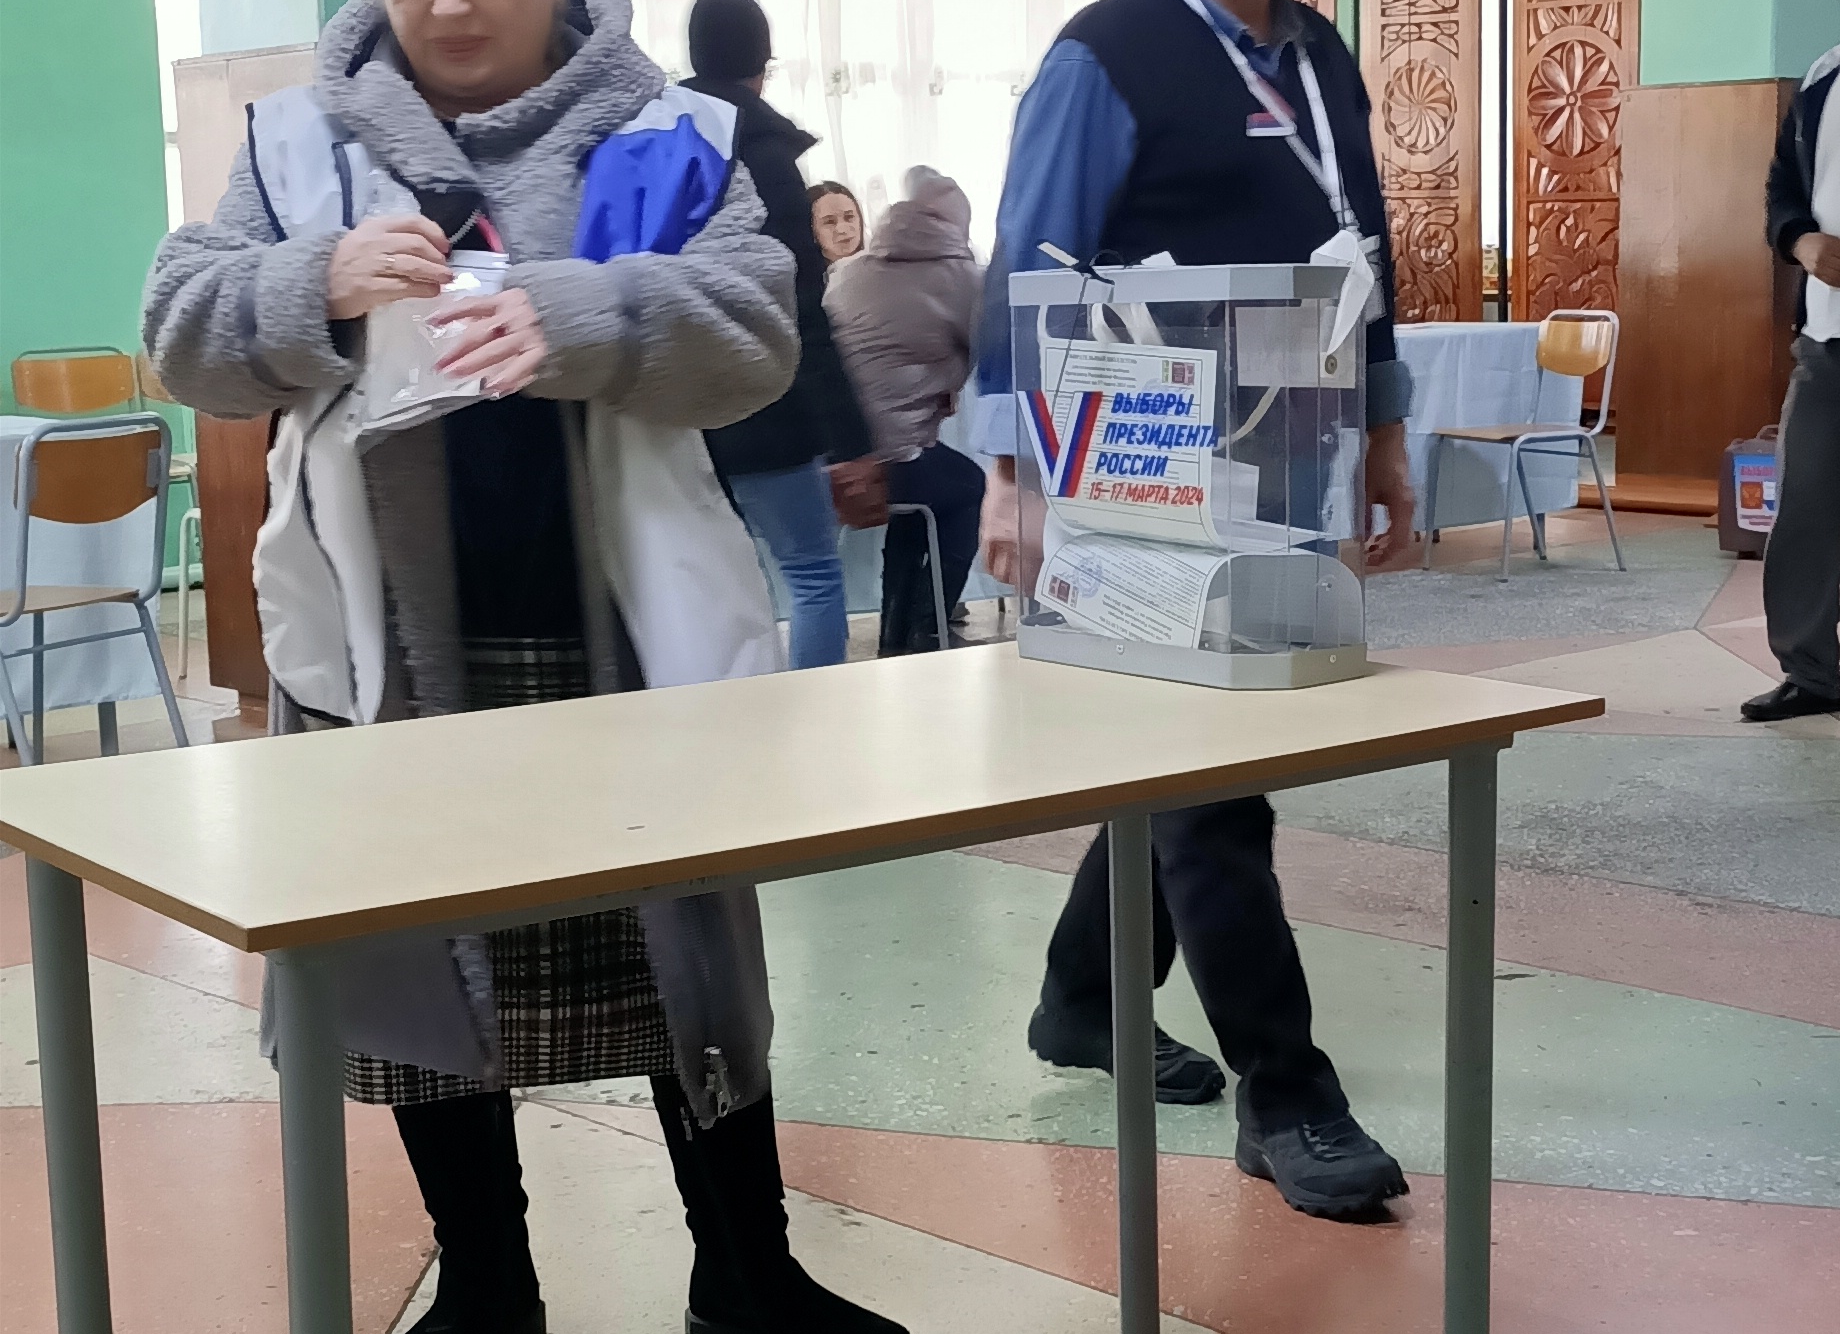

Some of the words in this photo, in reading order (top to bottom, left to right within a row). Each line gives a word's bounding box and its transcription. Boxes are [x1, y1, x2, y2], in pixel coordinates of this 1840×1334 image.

[1111, 392, 1195, 416] ВЫБОРЫ
[1103, 422, 1220, 449] ПРЕЗИДЕНТА
[1094, 451, 1169, 477] РОССИИ
[1124, 482, 1169, 505] МАРТА
[1170, 485, 1204, 506] 2024
